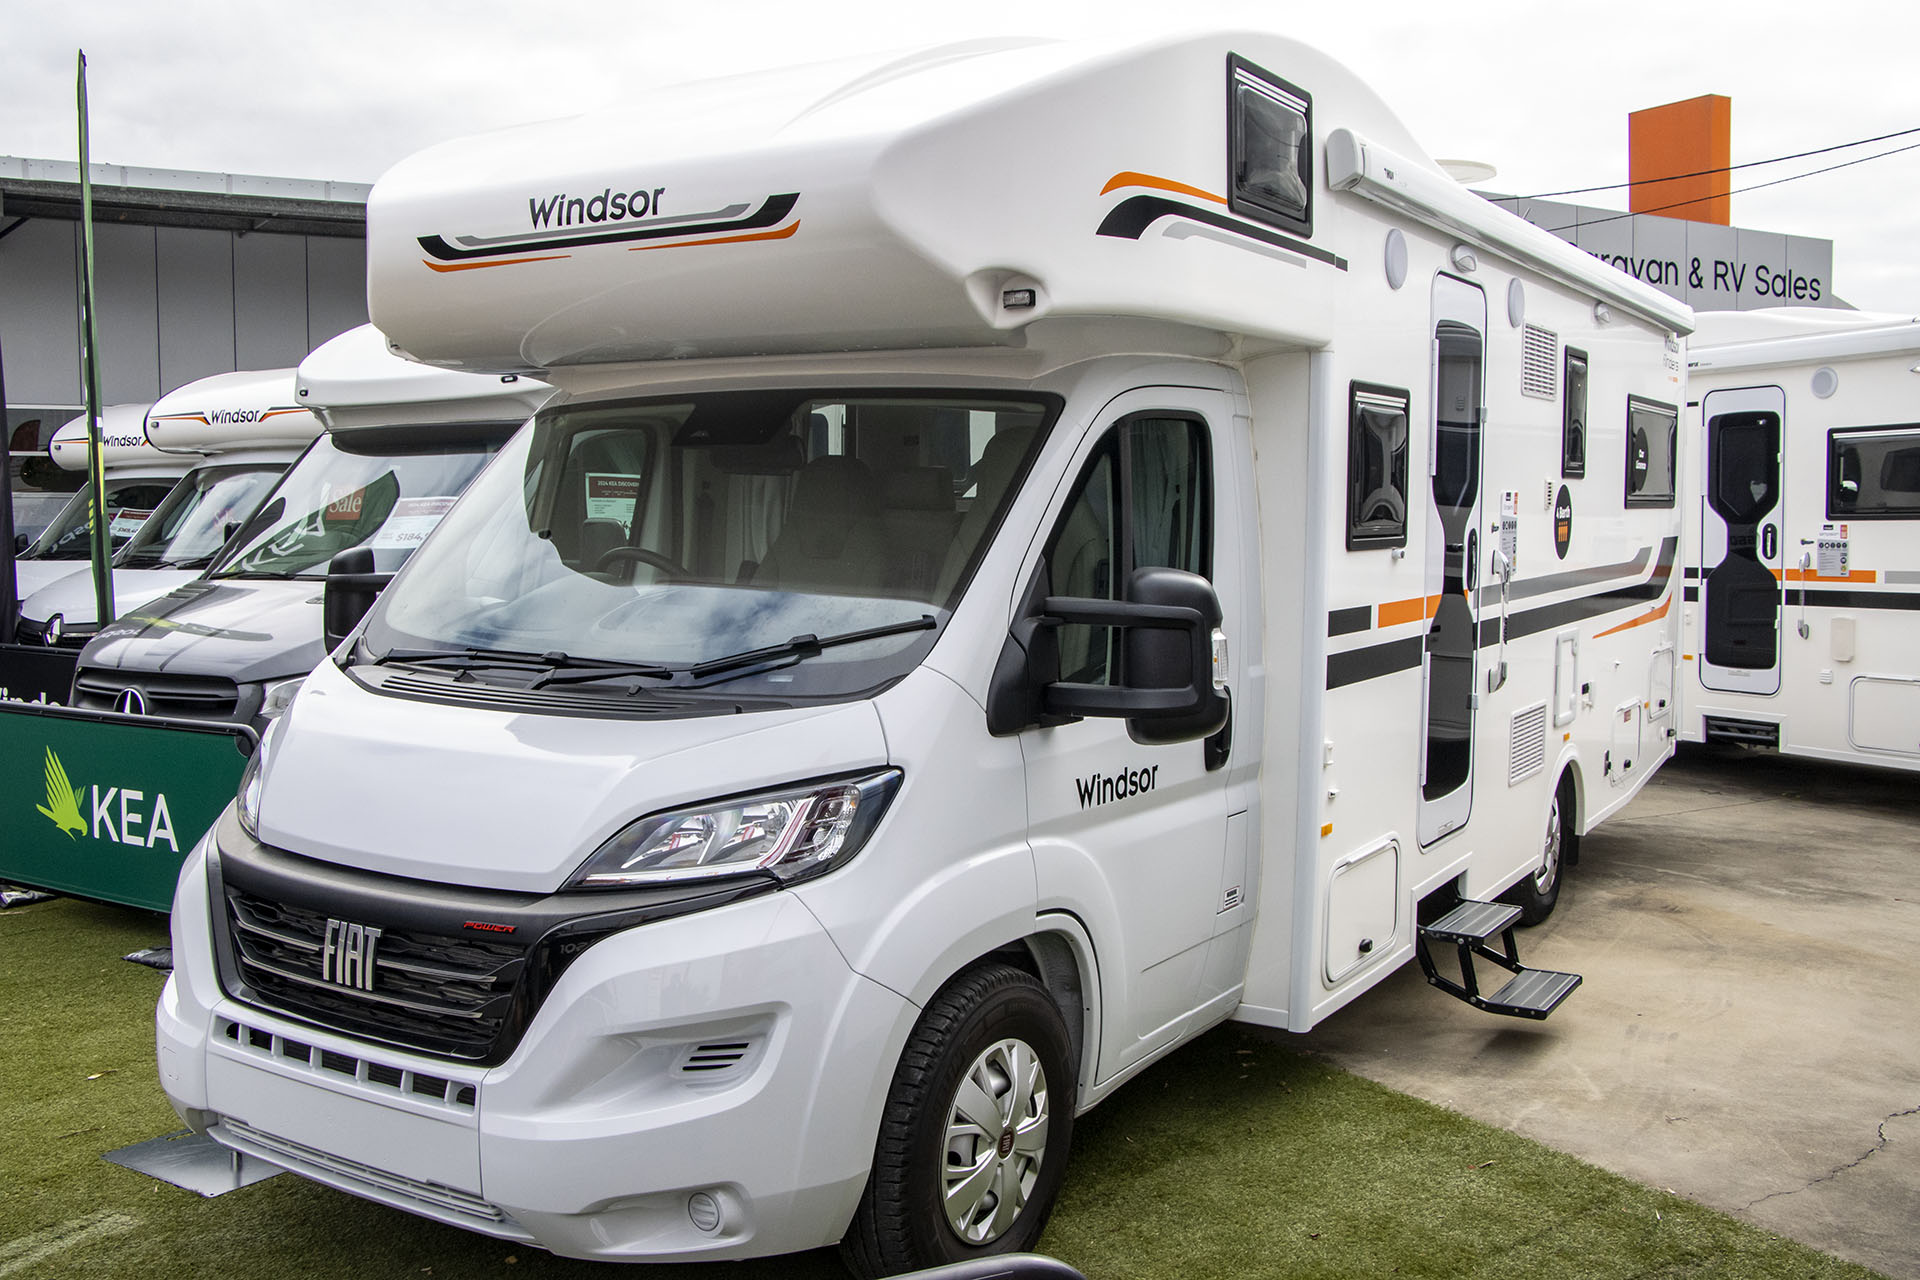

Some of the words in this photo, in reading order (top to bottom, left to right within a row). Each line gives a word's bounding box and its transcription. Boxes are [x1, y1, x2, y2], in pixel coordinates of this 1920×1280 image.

[529, 187, 666, 230] Windsor
[1568, 242, 1678, 286] avan
[1688, 257, 1703, 289] &
[1714, 260, 1746, 293] RV
[1755, 265, 1821, 301] Sales
[211, 409, 260, 424] Windsor
[103, 435, 142, 447] Windsor
[329, 493, 362, 513] Sale
[1075, 764, 1159, 810] Windsor
[92, 784, 179, 853] KEA
[463, 921, 516, 934] POWER
[322, 918, 382, 991] FIAT
